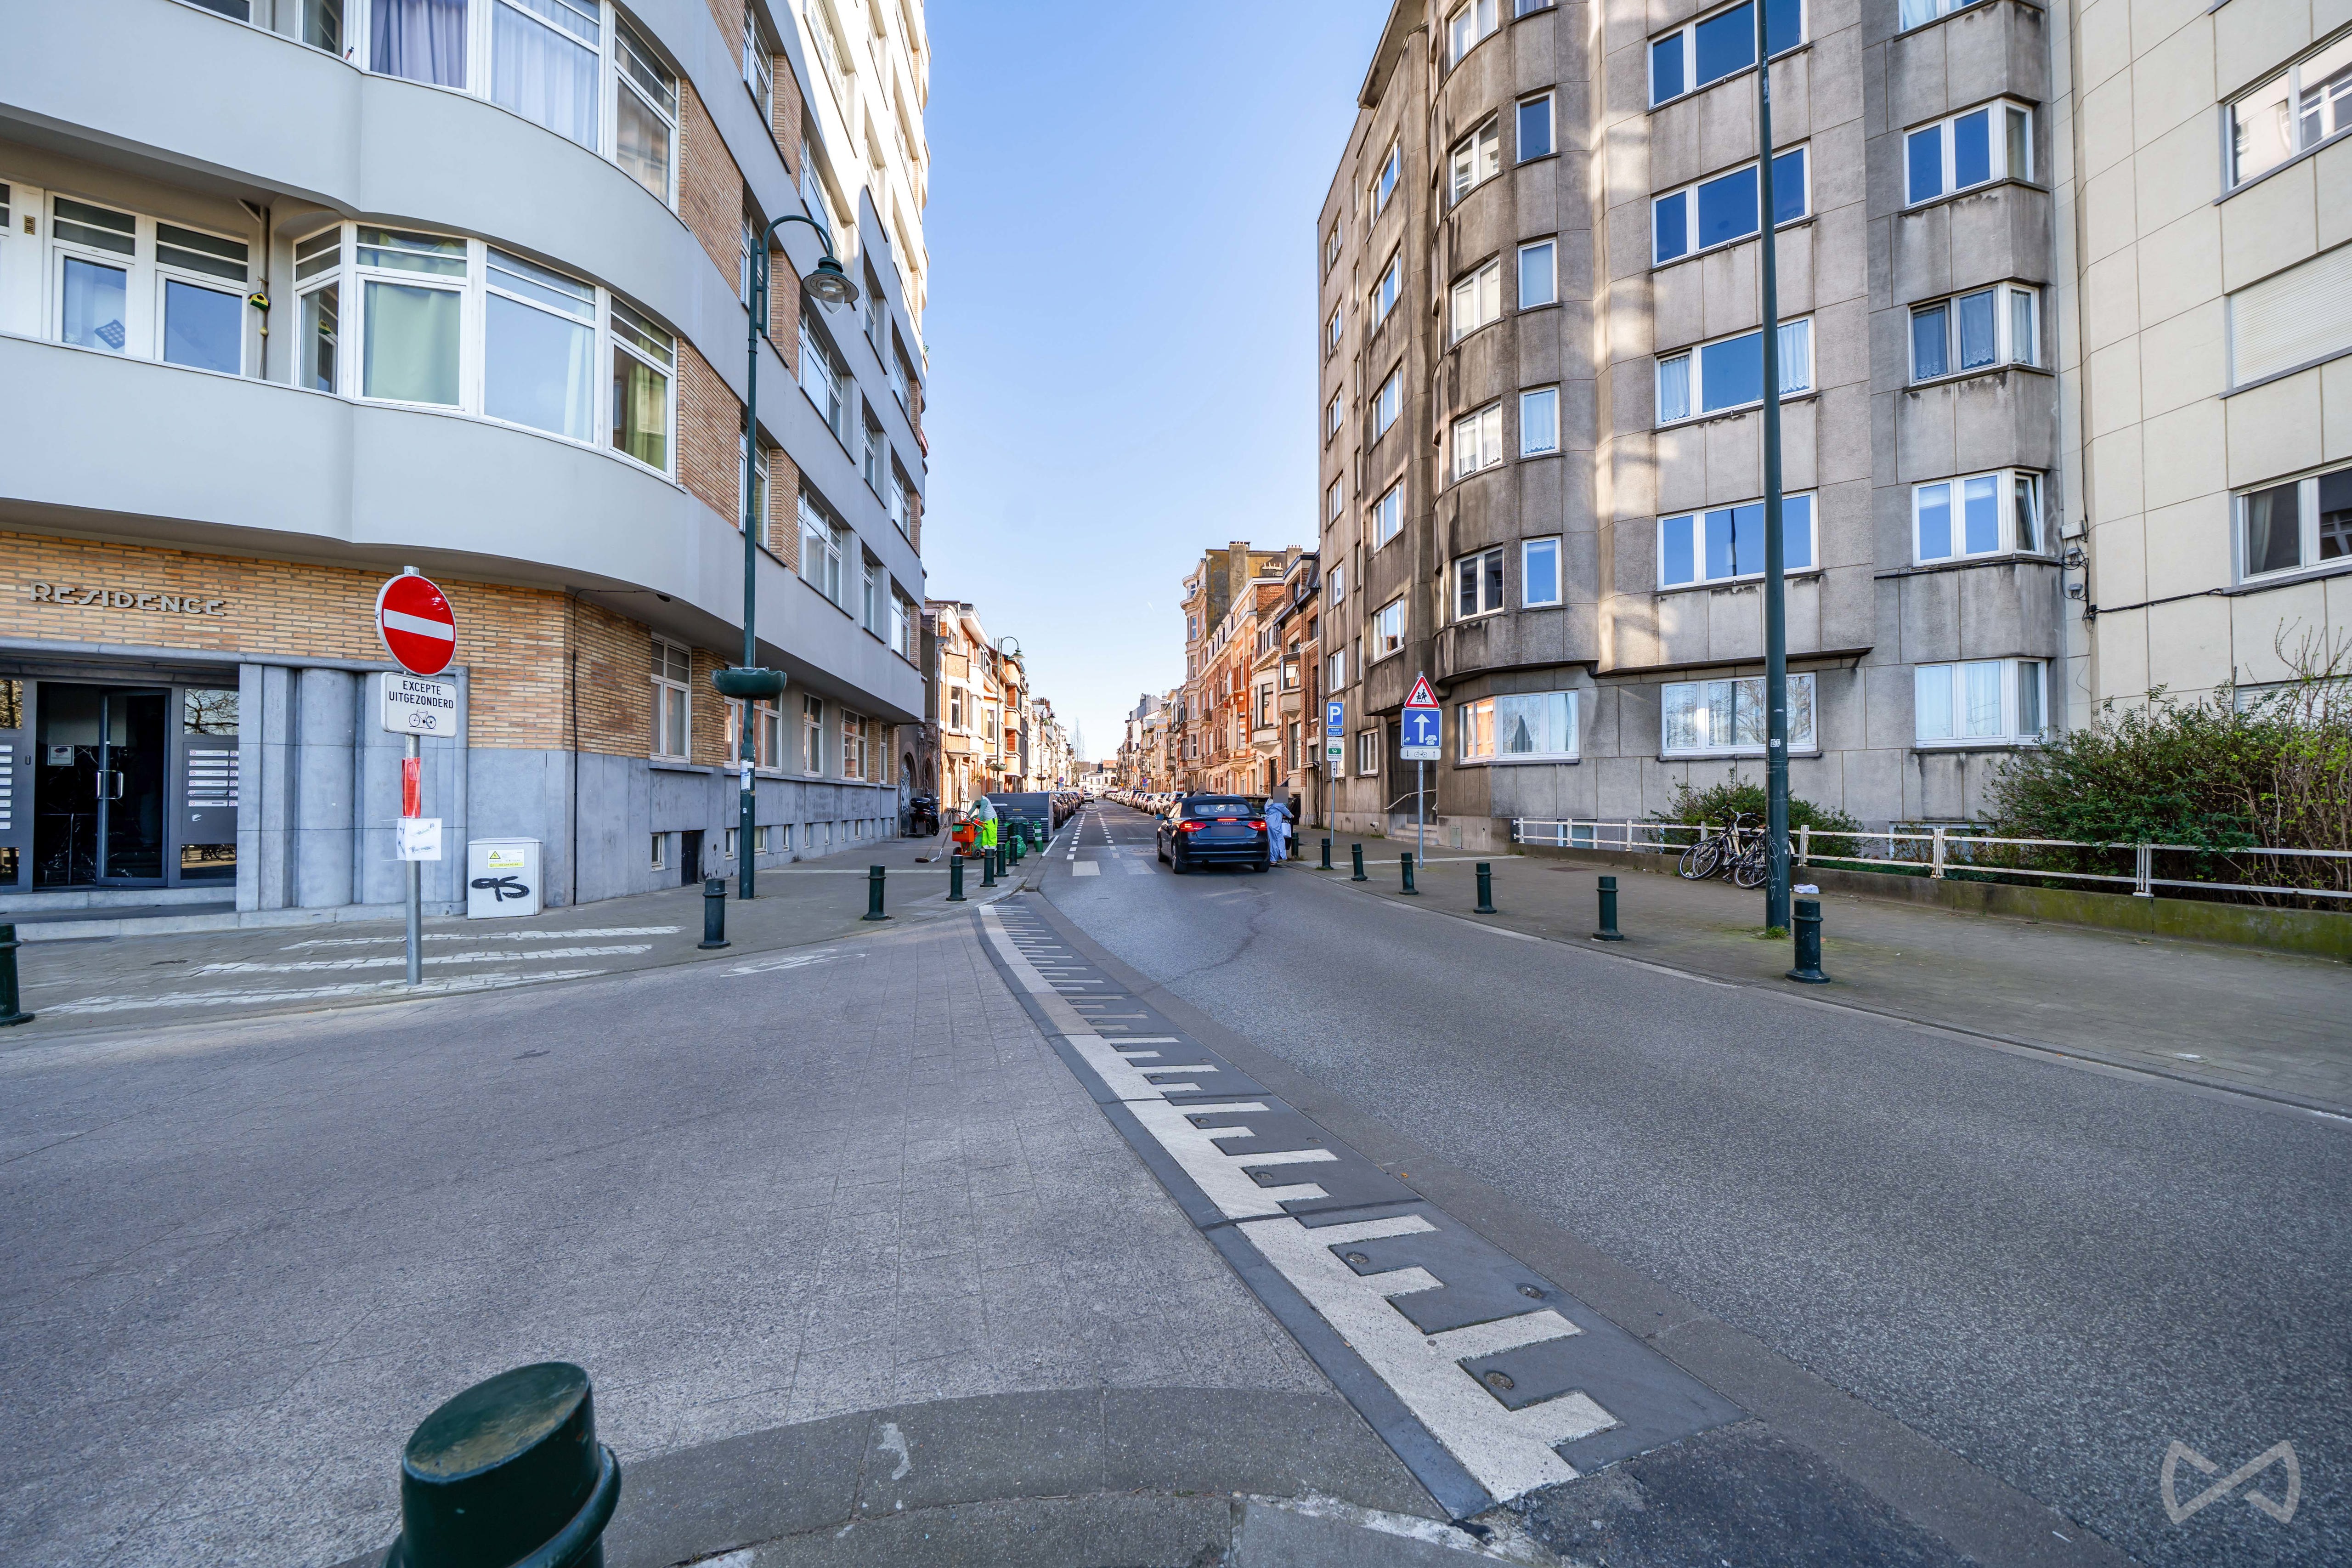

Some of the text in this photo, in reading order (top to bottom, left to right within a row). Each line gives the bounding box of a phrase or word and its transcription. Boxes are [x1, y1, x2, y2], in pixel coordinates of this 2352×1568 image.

[30, 581, 225, 616] RESIDENCE
[403, 680, 441, 695] EXCEPTE
[389, 691, 453, 708] UITGEZONDERD
[1330, 706, 1341, 722] P
